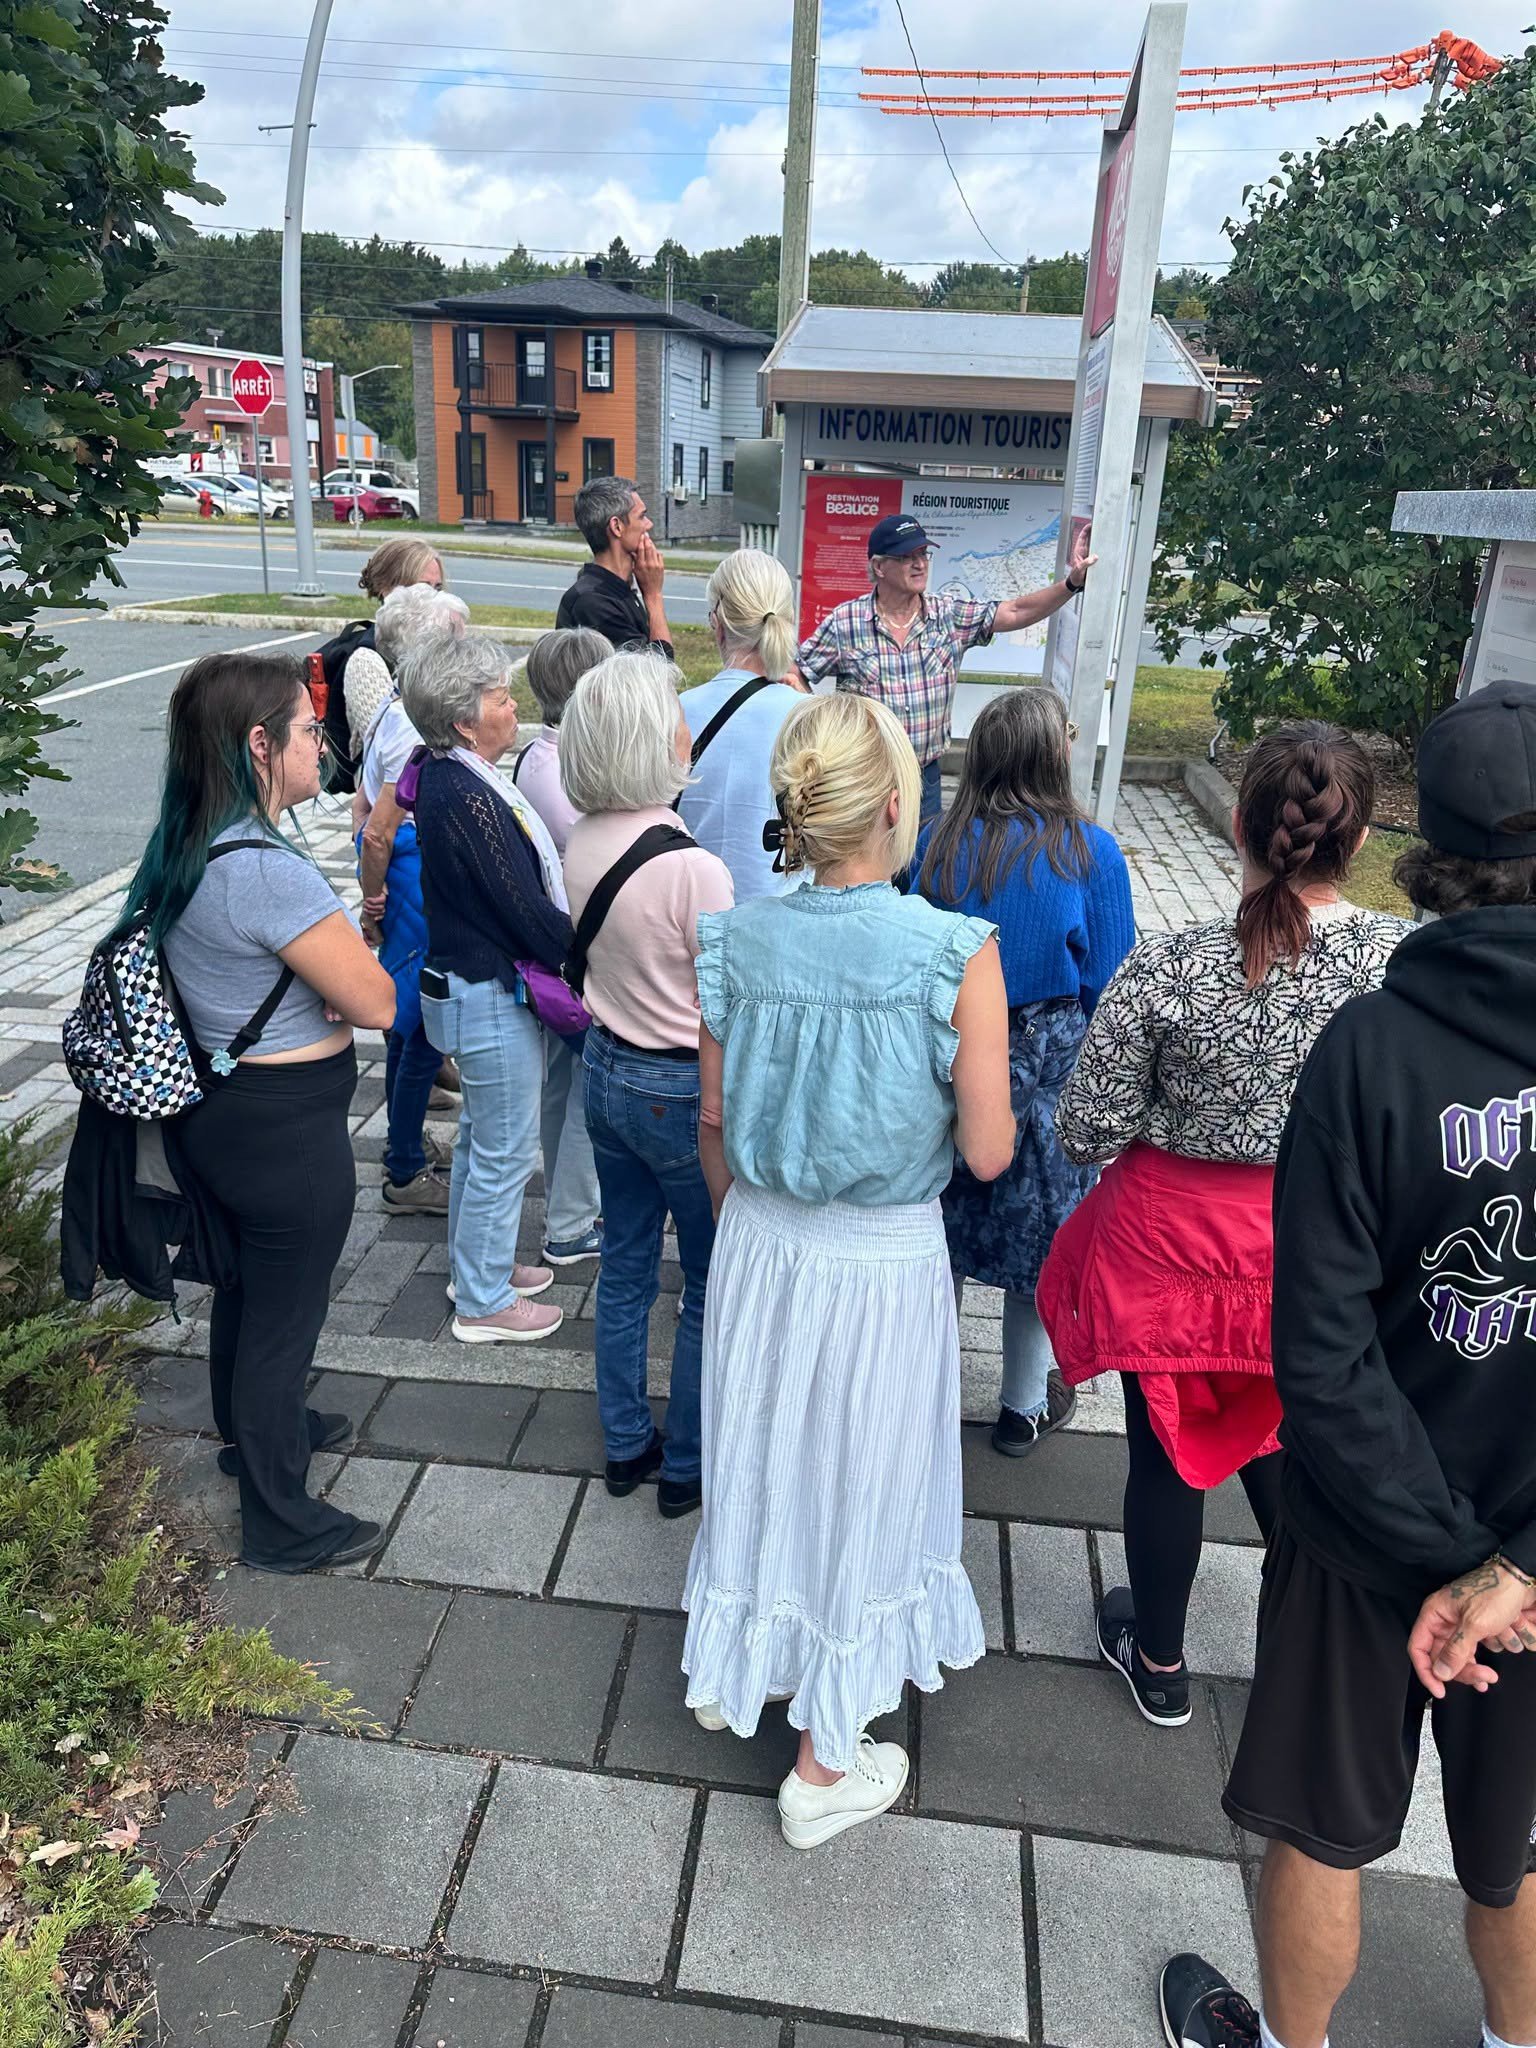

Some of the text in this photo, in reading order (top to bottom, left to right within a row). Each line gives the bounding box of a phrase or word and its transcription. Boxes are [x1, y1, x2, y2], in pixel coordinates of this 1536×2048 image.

[234, 375, 270, 396] ARRÊT
[819, 408, 973, 446] INFORMATION
[826, 494, 880, 503] DESTINATION
[912, 492, 1010, 511] RÉGION TOURISTIQUE
[825, 502, 879, 516] Beauce
